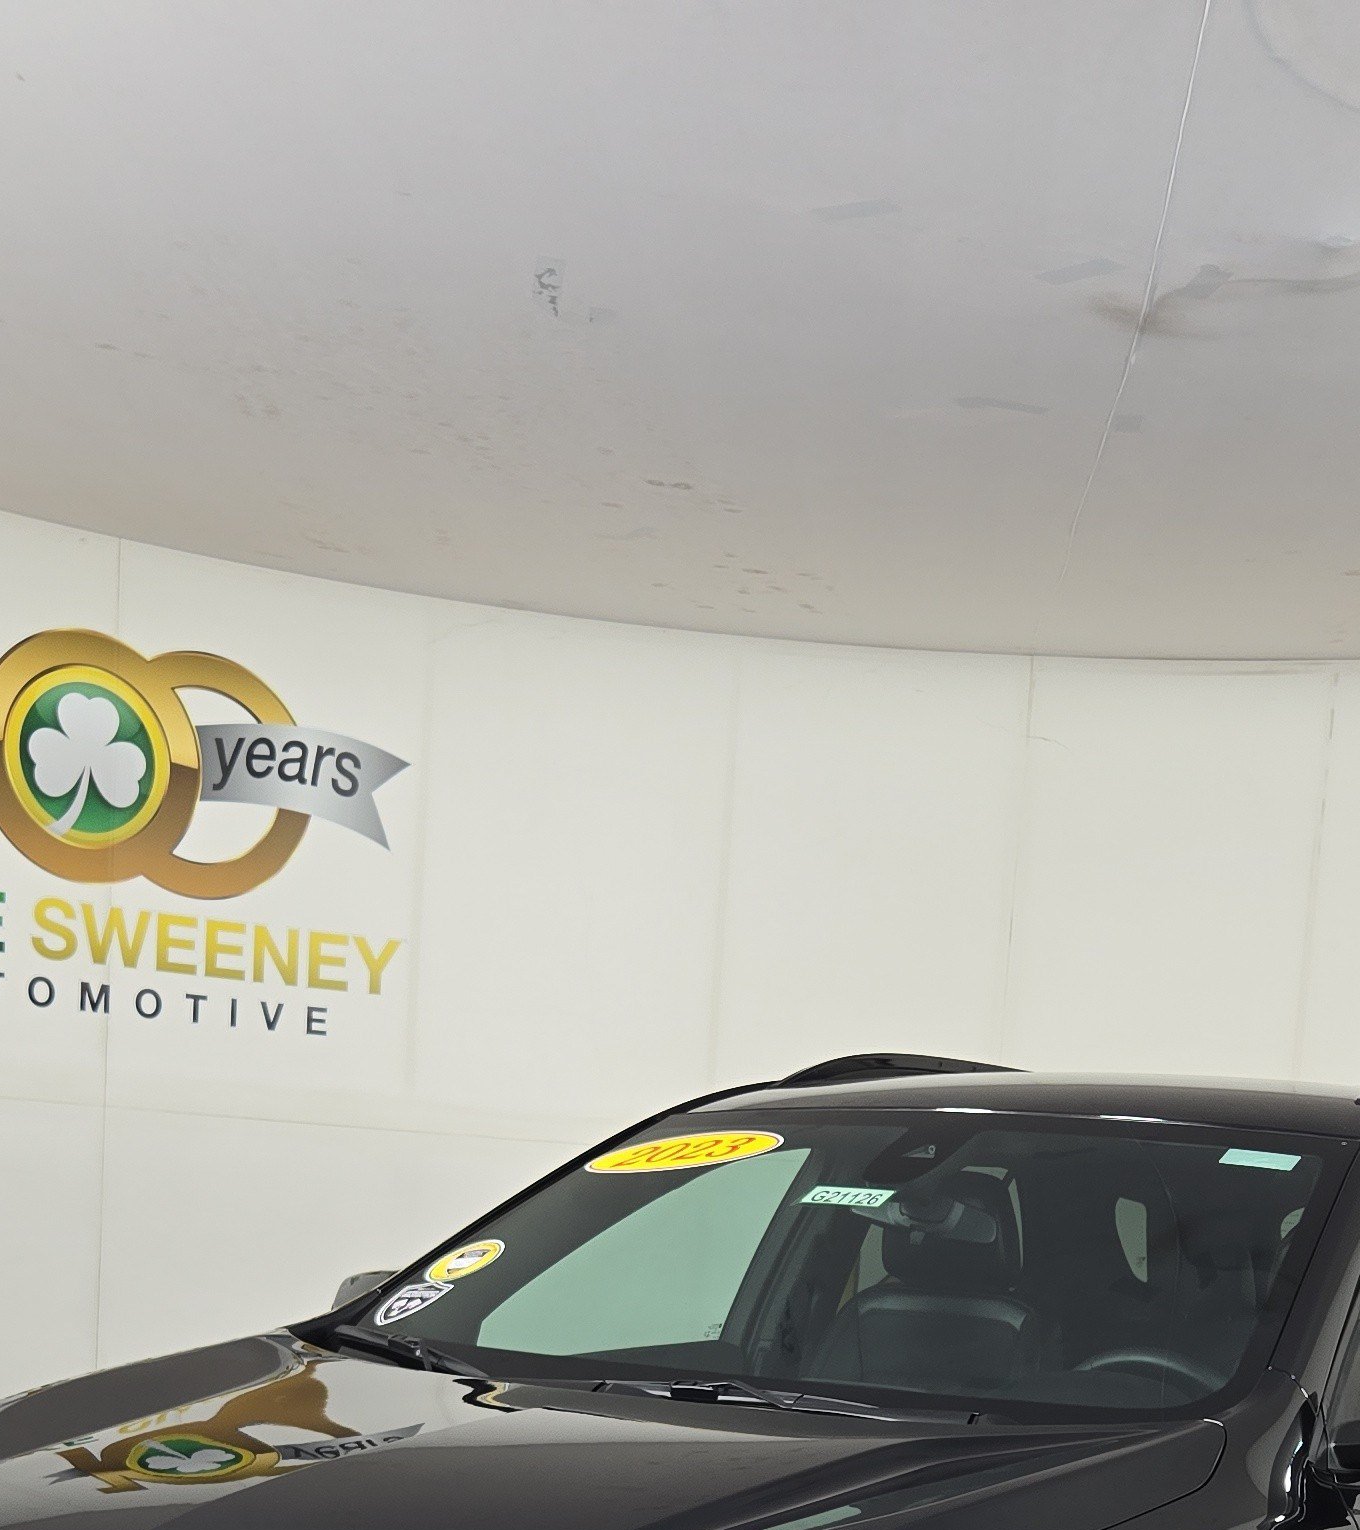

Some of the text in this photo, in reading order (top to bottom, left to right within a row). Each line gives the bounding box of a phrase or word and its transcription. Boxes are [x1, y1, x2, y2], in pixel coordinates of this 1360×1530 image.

[212, 734, 362, 798] years
[31, 897, 402, 996] SWEENEY
[609, 1137, 756, 1168] 2023
[811, 1190, 883, 1205] G21126
